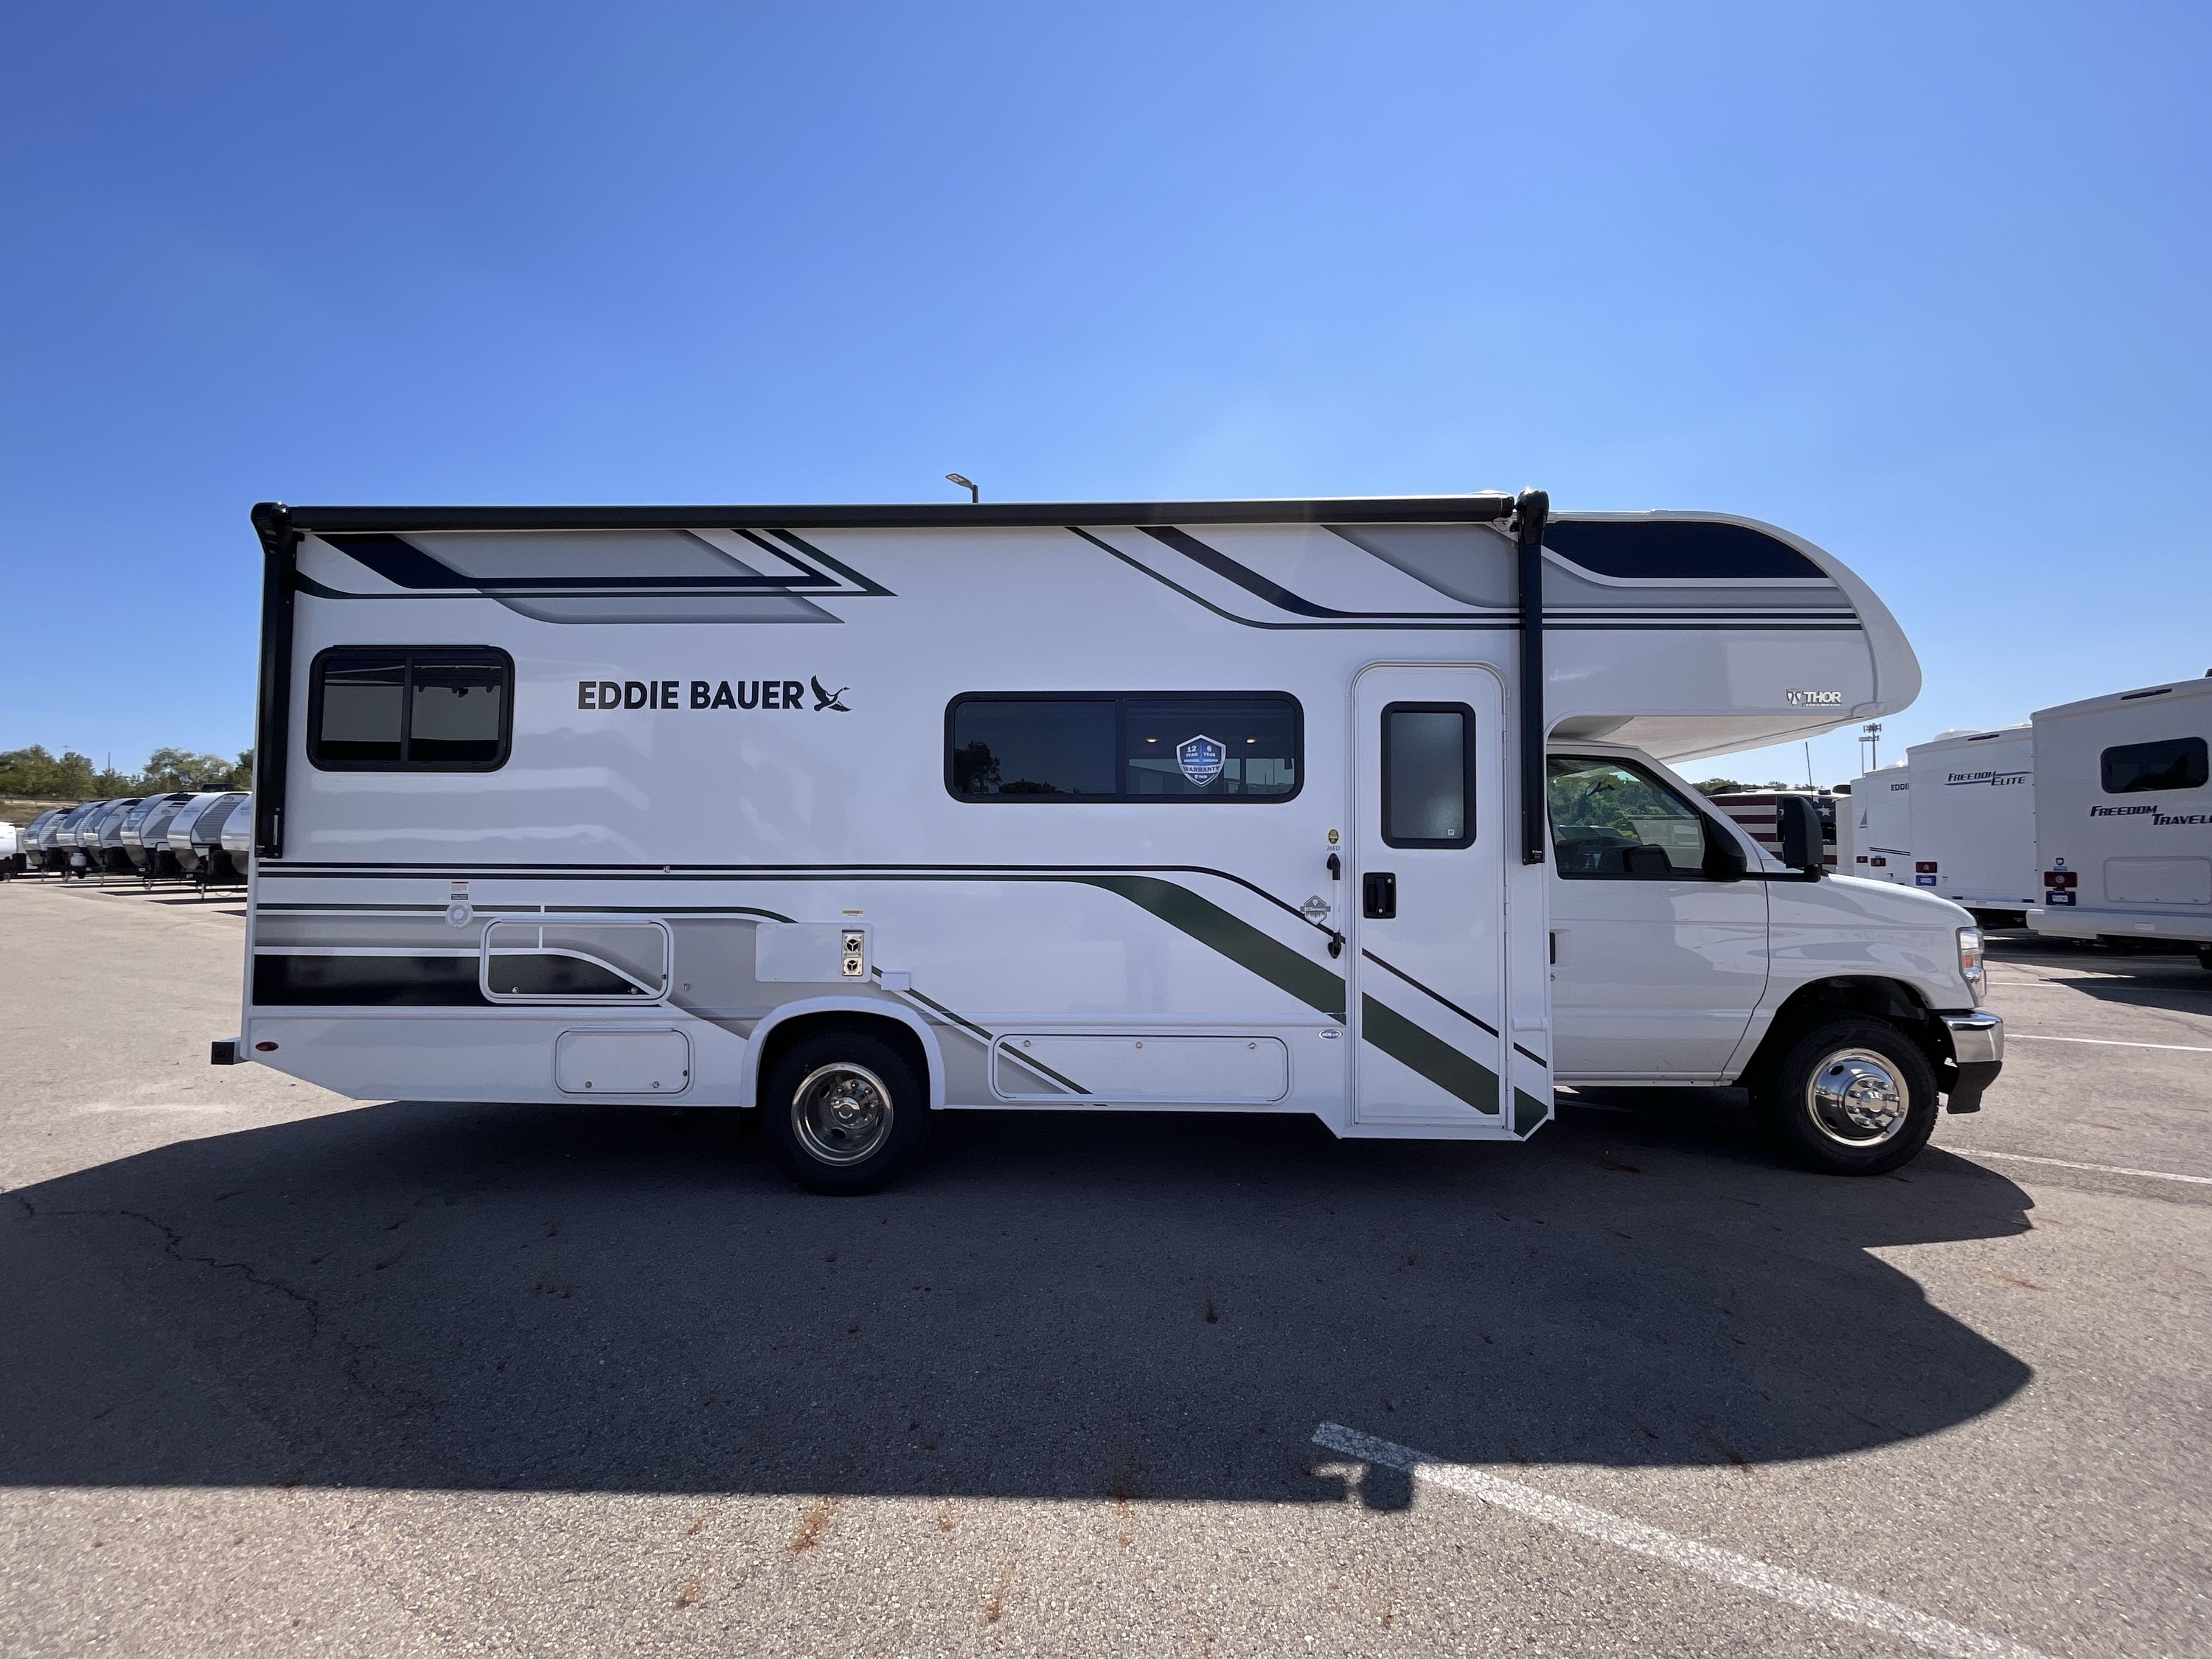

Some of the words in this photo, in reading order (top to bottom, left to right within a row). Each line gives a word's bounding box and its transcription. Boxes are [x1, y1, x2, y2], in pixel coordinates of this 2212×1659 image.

[578, 681, 680, 710] EDDIE
[690, 681, 804, 710] BAUER
[1803, 691, 1842, 703] THOR
[1183, 765, 1220, 773] WARRANTY
[1947, 771, 1996, 782] FREEDOM
[1991, 776, 2026, 786] ELITE
[2090, 805, 2157, 817] FREEDOM
